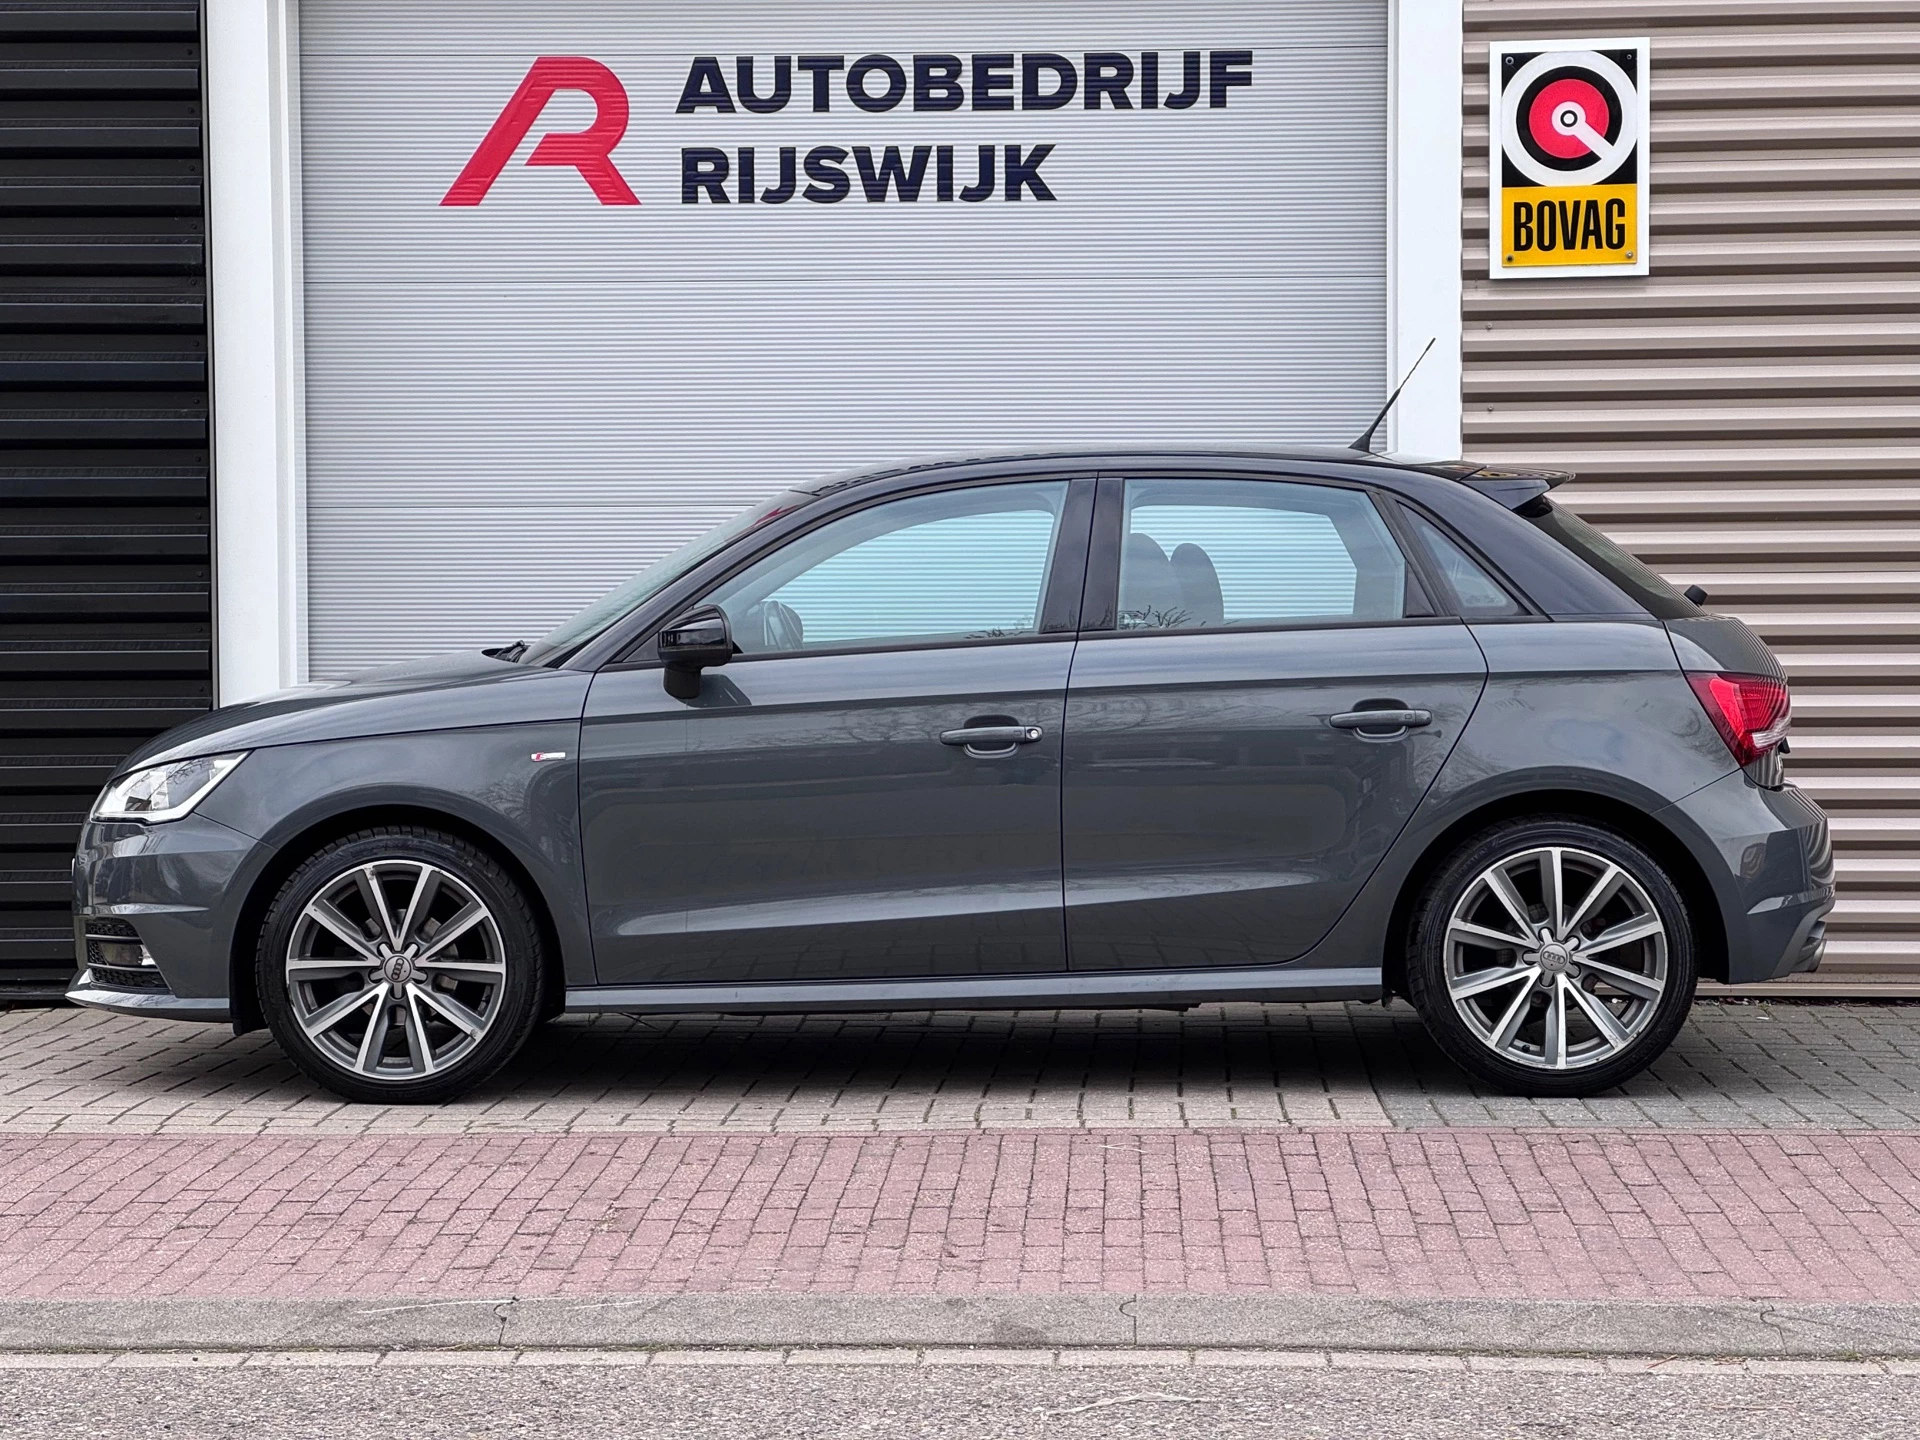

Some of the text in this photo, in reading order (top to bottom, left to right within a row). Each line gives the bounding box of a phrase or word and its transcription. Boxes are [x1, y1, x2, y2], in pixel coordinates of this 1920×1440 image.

[676, 50, 1253, 114] AUTOBEDRIJF
[681, 144, 1058, 205] RIJSWIJK
[1513, 198, 1626, 252] BOVAG
